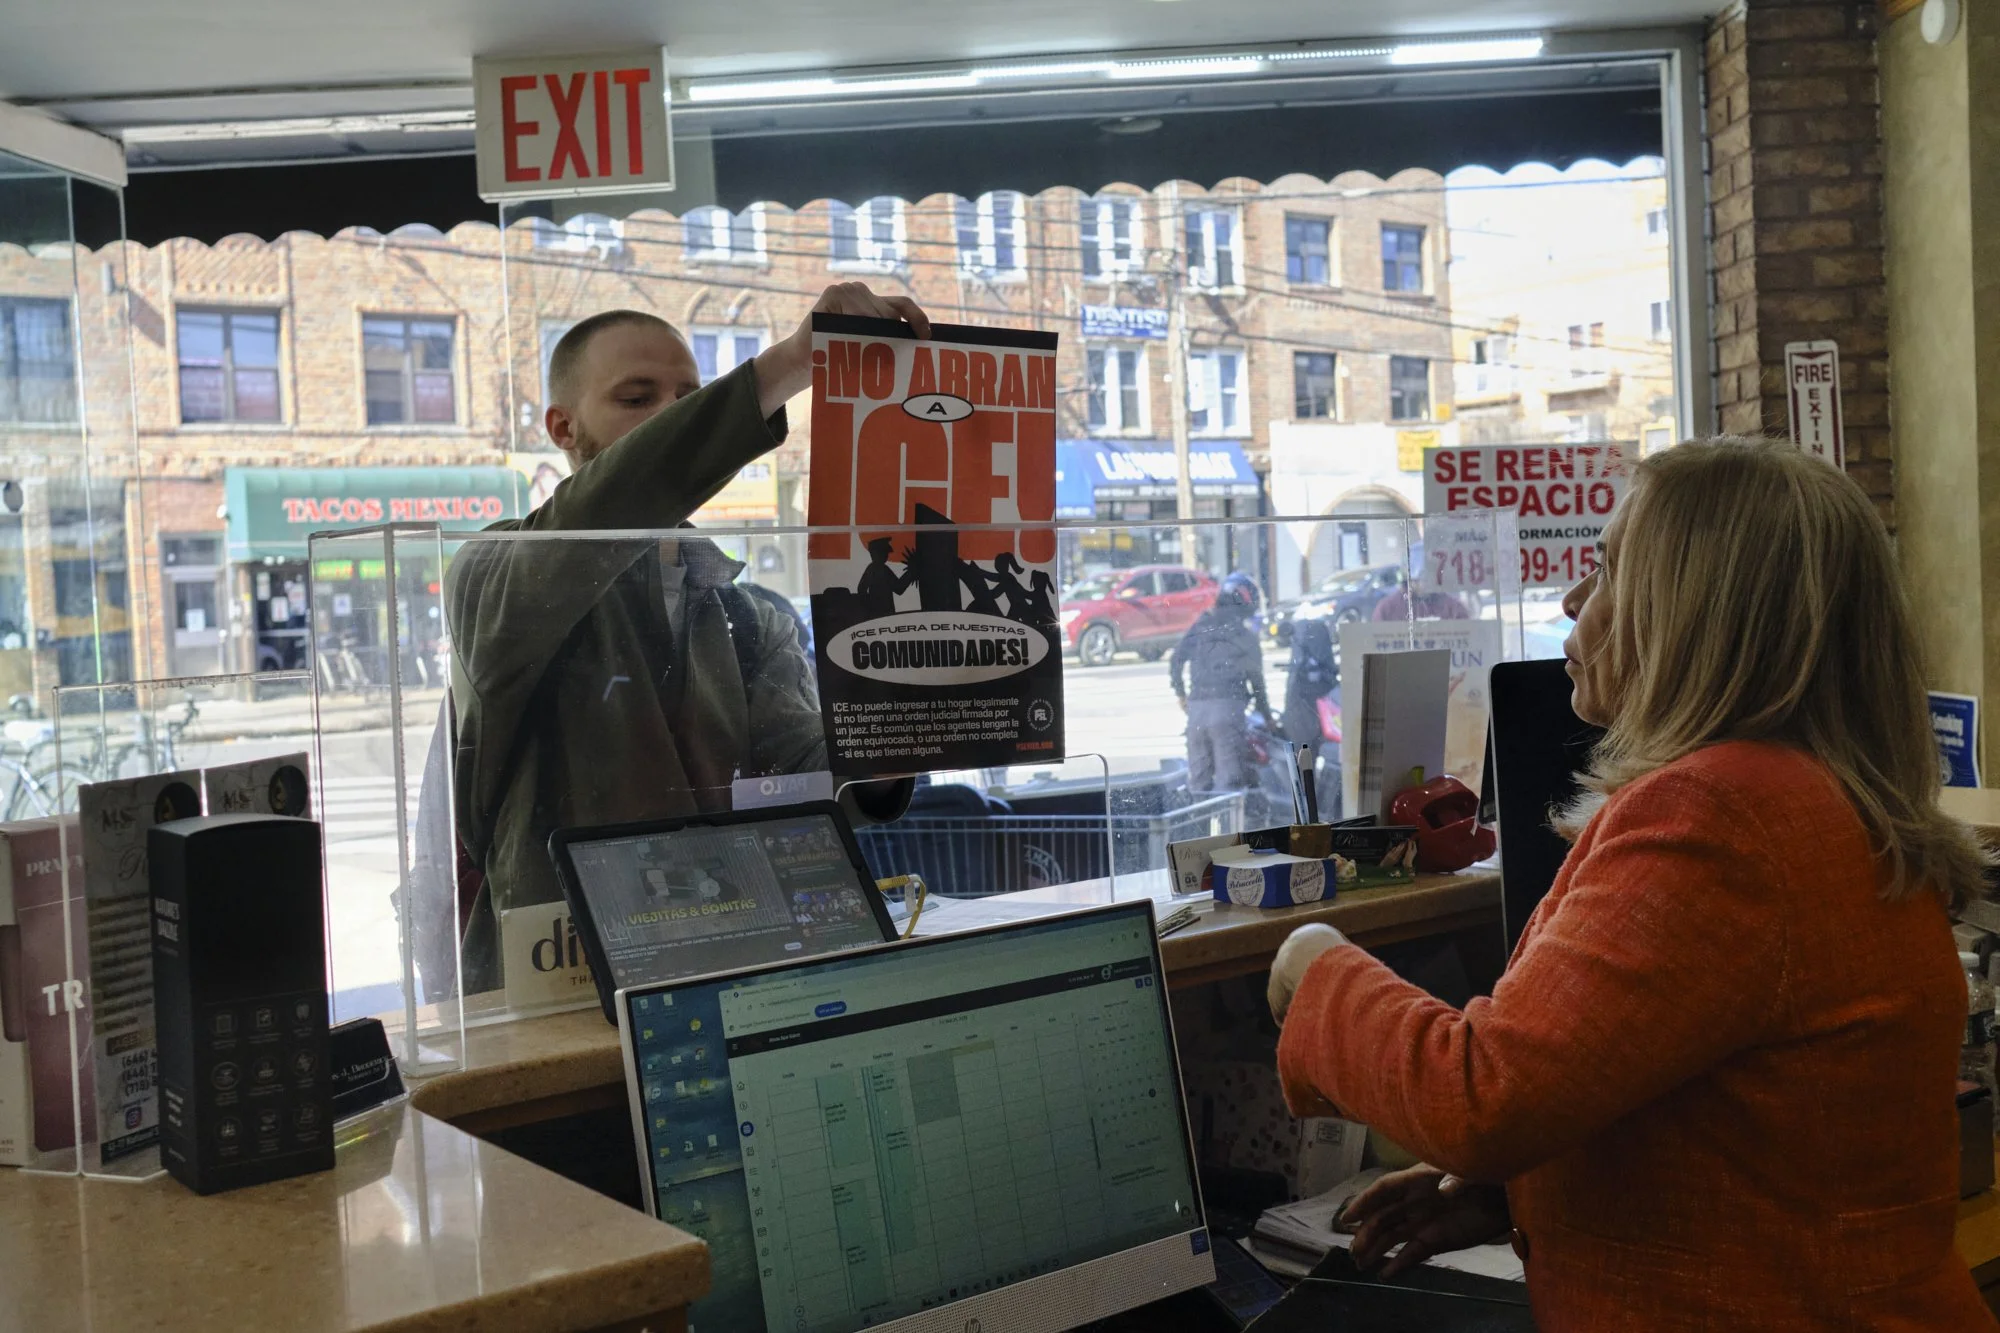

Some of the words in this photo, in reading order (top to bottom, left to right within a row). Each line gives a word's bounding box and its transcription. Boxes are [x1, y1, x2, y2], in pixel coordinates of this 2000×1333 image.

[501, 68, 650, 182] EXIT
[812, 340, 895, 401] ¡NO
[908, 346, 1055, 409] ABRAN
[1795, 363, 1831, 383] FIRE
[926, 401, 947, 415] A
[1808, 387, 1824, 455] EXTIN
[1434, 450, 1482, 484] SE
[1496, 446, 1627, 481] RENTA
[807, 402, 1056, 564] ICE!
[283, 497, 383, 523] TACOS
[389, 496, 503, 521] MEXICO
[1447, 482, 1615, 517] ESPACIO
[1519, 526, 1603, 540] ORMACIÓN
[1432, 546, 1596, 585] 718-99-15
[851, 629, 876, 641] ¡ICE
[879, 624, 927, 637] FUERA
[931, 624, 950, 632] DE
[952, 623, 1026, 636] NUESTRAS
[852, 638, 1030, 670] COMUNIDADES!
[1451, 650, 1483, 668] UN
[833, 702, 849, 712] ICE
[850, 703, 863, 712] no
[864, 701, 892, 713] puede
[894, 700, 929, 712] ingresar
[931, 701, 936, 709] a
[938, 700, 946, 708] tu
[948, 698, 971, 709] hogar
[973, 697, 1019, 709] legalmente
[834, 714, 841, 724] si
[843, 715, 855, 723] no
[857, 713, 884, 723] tienen
[886, 713, 902, 722] una
[904, 711, 929, 721] orden
[931, 709, 960, 722] judicial
[962, 709, 993, 719] firmada
[995, 709, 1009, 719] por
[835, 727, 847, 735] un
[848, 725, 869, 737] juez.
[870, 724, 882, 734] Es
[883, 723, 914, 733] común
[915, 723, 932, 734] que
[933, 722, 946, 731] los
[947, 721, 980, 732] agentes
[982, 720, 1010, 730] tengan
[1011, 718, 1019, 727] la
[836, 736, 862, 747] orden
[863, 734, 916, 747] equivocada,
[917, 735, 924, 743] o
[925, 734, 941, 742] una
[942, 732, 967, 742] orden
[968, 733, 979, 741] no
[980, 730, 1018, 741] completa
[845, 749, 852, 758] si
[854, 750, 865, 758] es
[866, 749, 883, 759] que
[884, 746, 911, 757] tienen
[912, 745, 944, 757] alguna.
[628, 908, 687, 925] VIEJITAS
[689, 906, 700, 916] &
[701, 899, 757, 916] BONITAS
[531, 918, 579, 972] di
[42, 980, 85, 1016] TR
